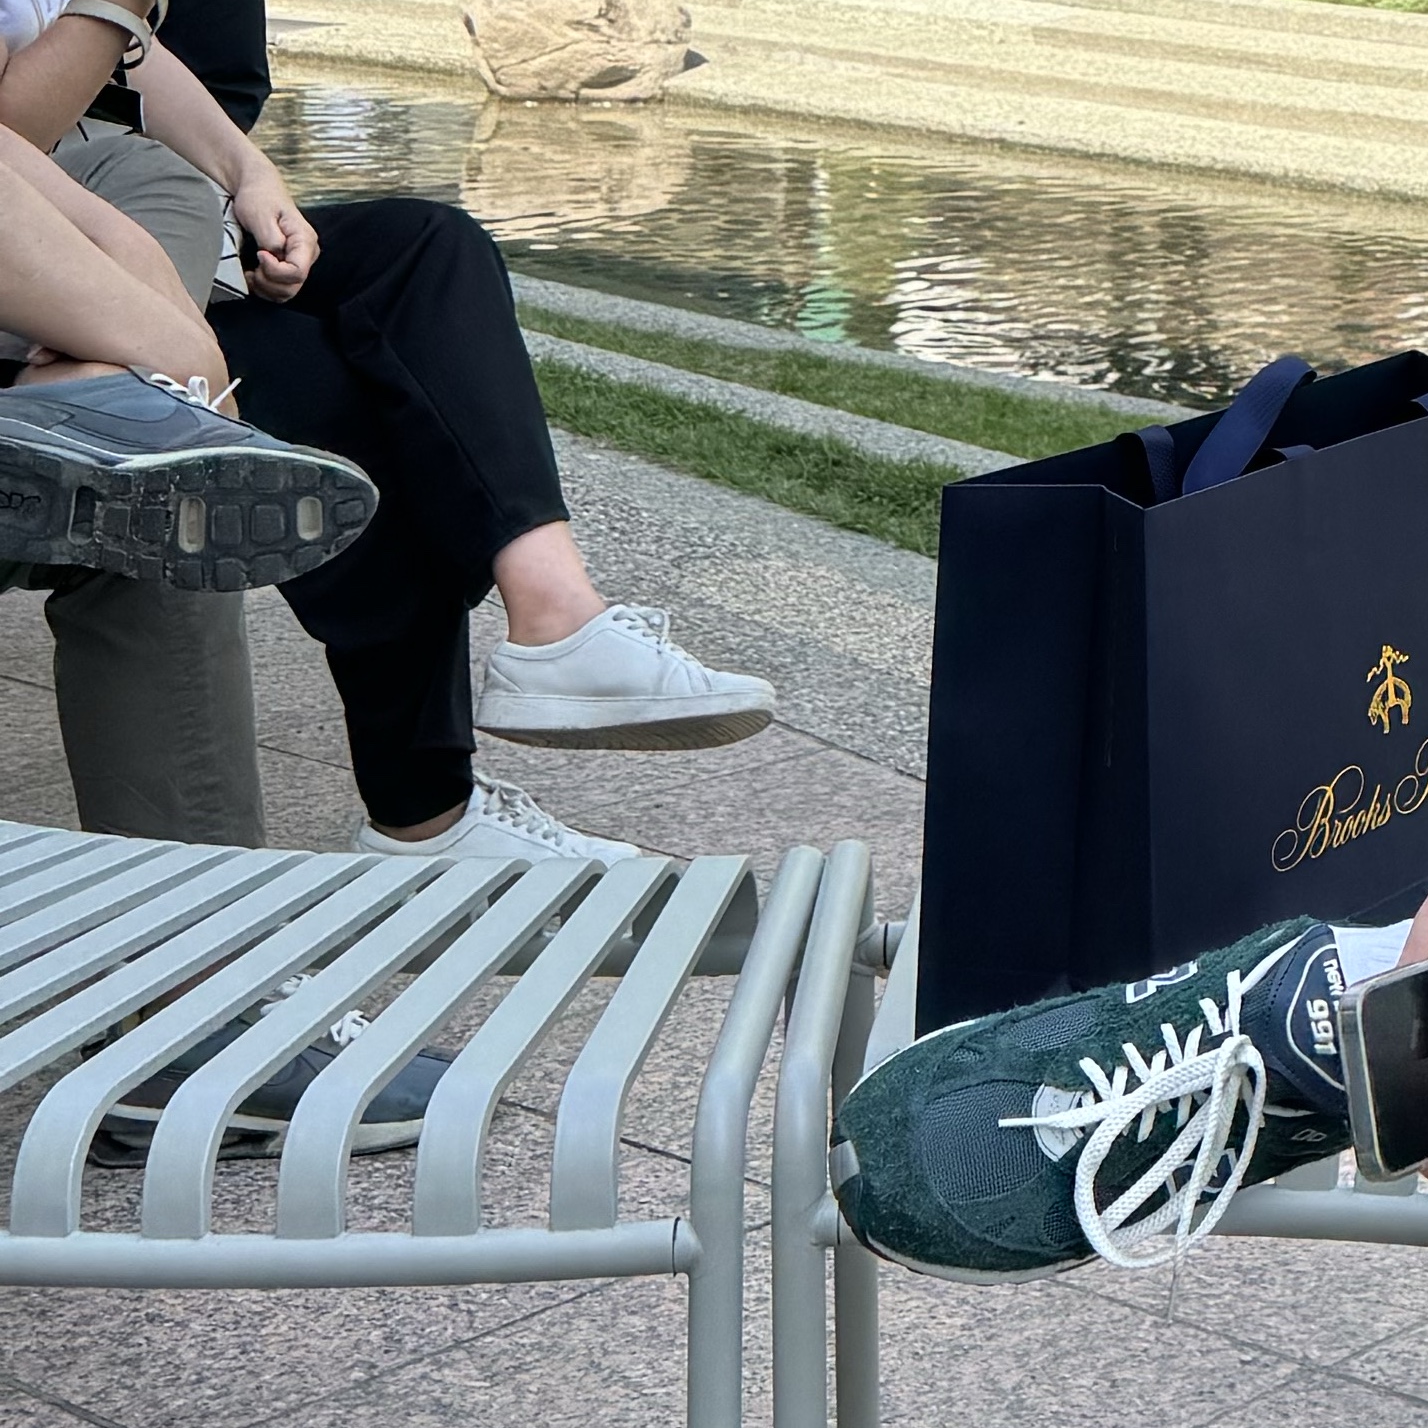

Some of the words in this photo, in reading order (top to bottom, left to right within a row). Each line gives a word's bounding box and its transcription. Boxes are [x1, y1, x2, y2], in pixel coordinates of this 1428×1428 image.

[1272, 765, 1392, 871] Brooks
[1322, 958, 1345, 996] new
[1306, 998, 1337, 1055] 991
